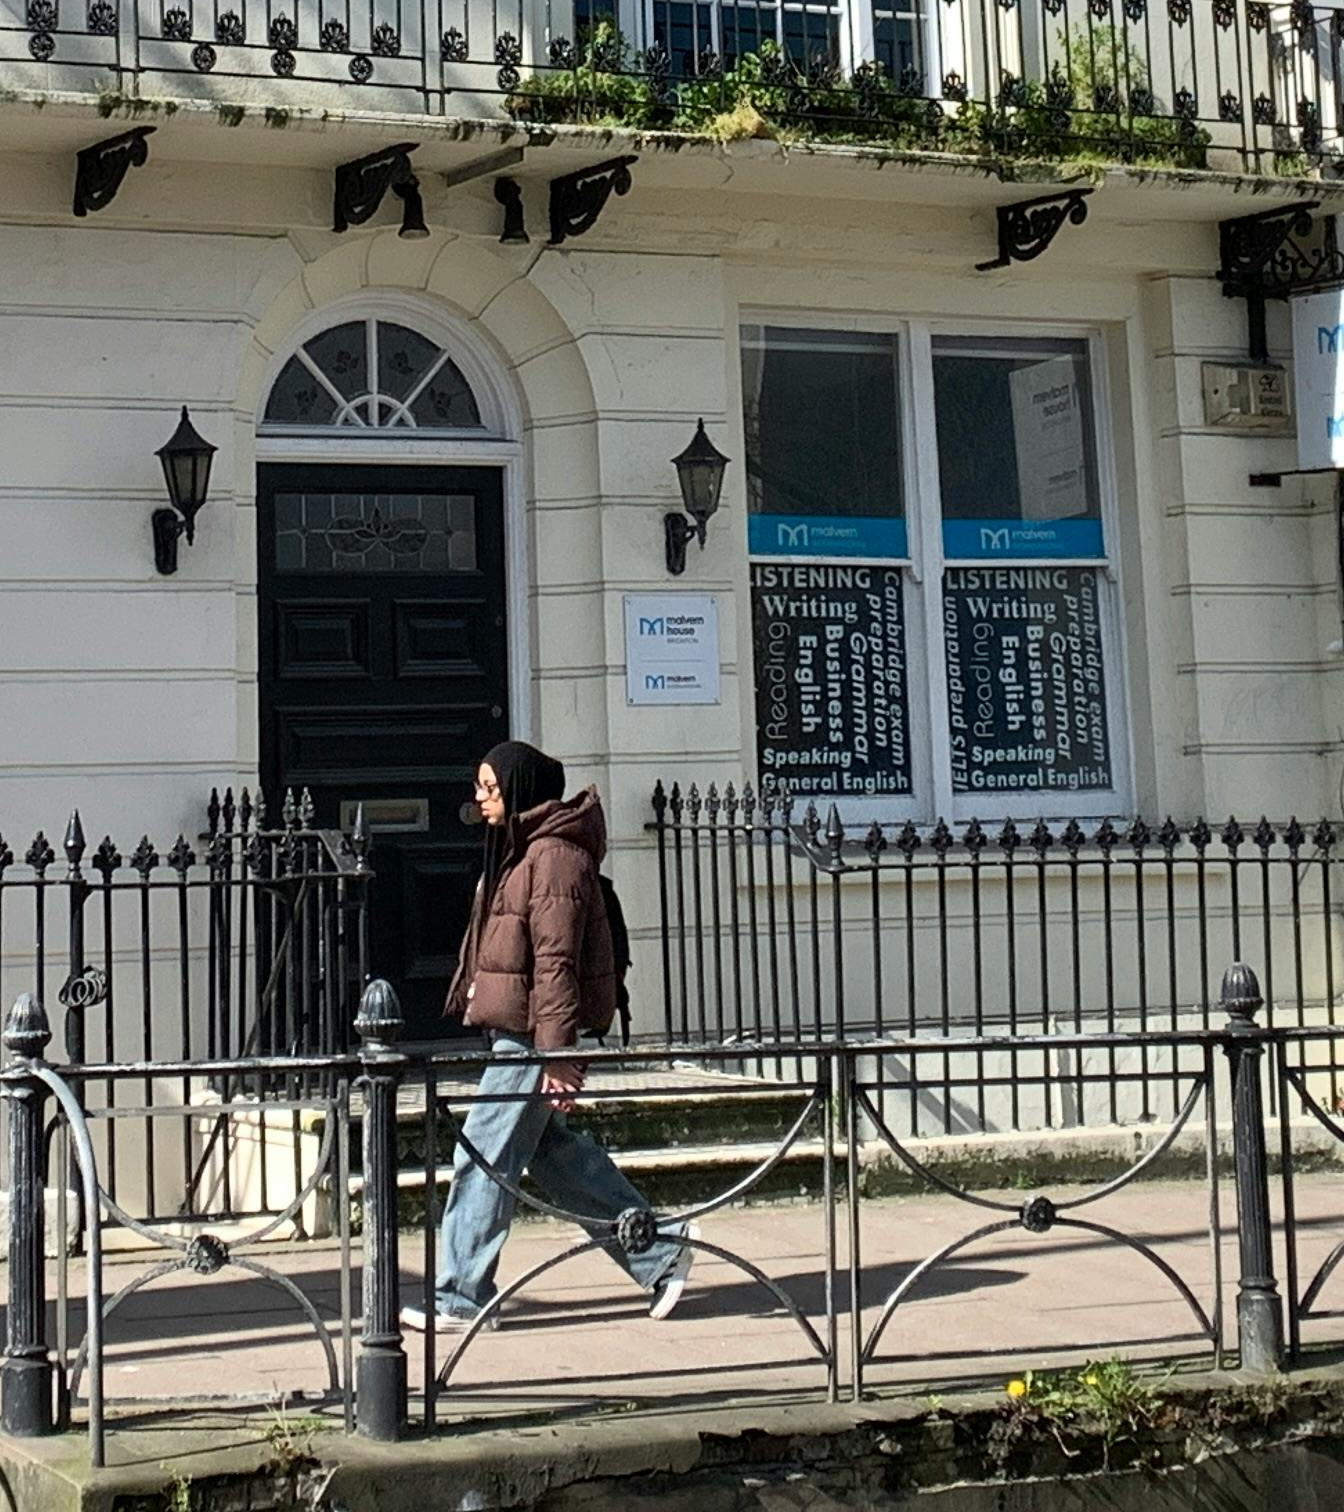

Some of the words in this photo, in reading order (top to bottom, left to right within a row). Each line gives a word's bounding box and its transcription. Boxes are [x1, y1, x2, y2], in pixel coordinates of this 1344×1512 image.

[811, 525, 858, 538] malvern
[1012, 529, 1056, 541] malvern
[750, 567, 871, 589] ISTENING
[946, 570, 1069, 590] LISTENING
[666, 615, 705, 625] malvern
[666, 626, 695, 636] house
[762, 595, 859, 624] Writing
[884, 571, 904, 697] Cambridge
[965, 596, 1057, 624] Writing
[1079, 572, 1102, 695] Cambridge
[764, 622, 791, 739] Reading
[794, 635, 823, 733] English
[825, 625, 846, 743] Business
[865, 593, 889, 748] preparation
[944, 596, 968, 729] preparation
[970, 622, 995, 738] Reading
[998, 635, 1026, 731] English
[1026, 625, 1048, 741] Business
[1063, 593, 1090, 744] preparation
[850, 631, 870, 764] Grammar
[1050, 631, 1072, 760] Grammar
[762, 747, 852, 769] Speaking
[889, 703, 906, 766] exam
[951, 734, 969, 791] IELTS
[971, 744, 1055, 766] Speaking
[1089, 701, 1106, 762] exam
[762, 772, 838, 791] General
[842, 770, 908, 794] English
[971, 768, 1043, 787] General
[1048, 766, 1109, 789] English
